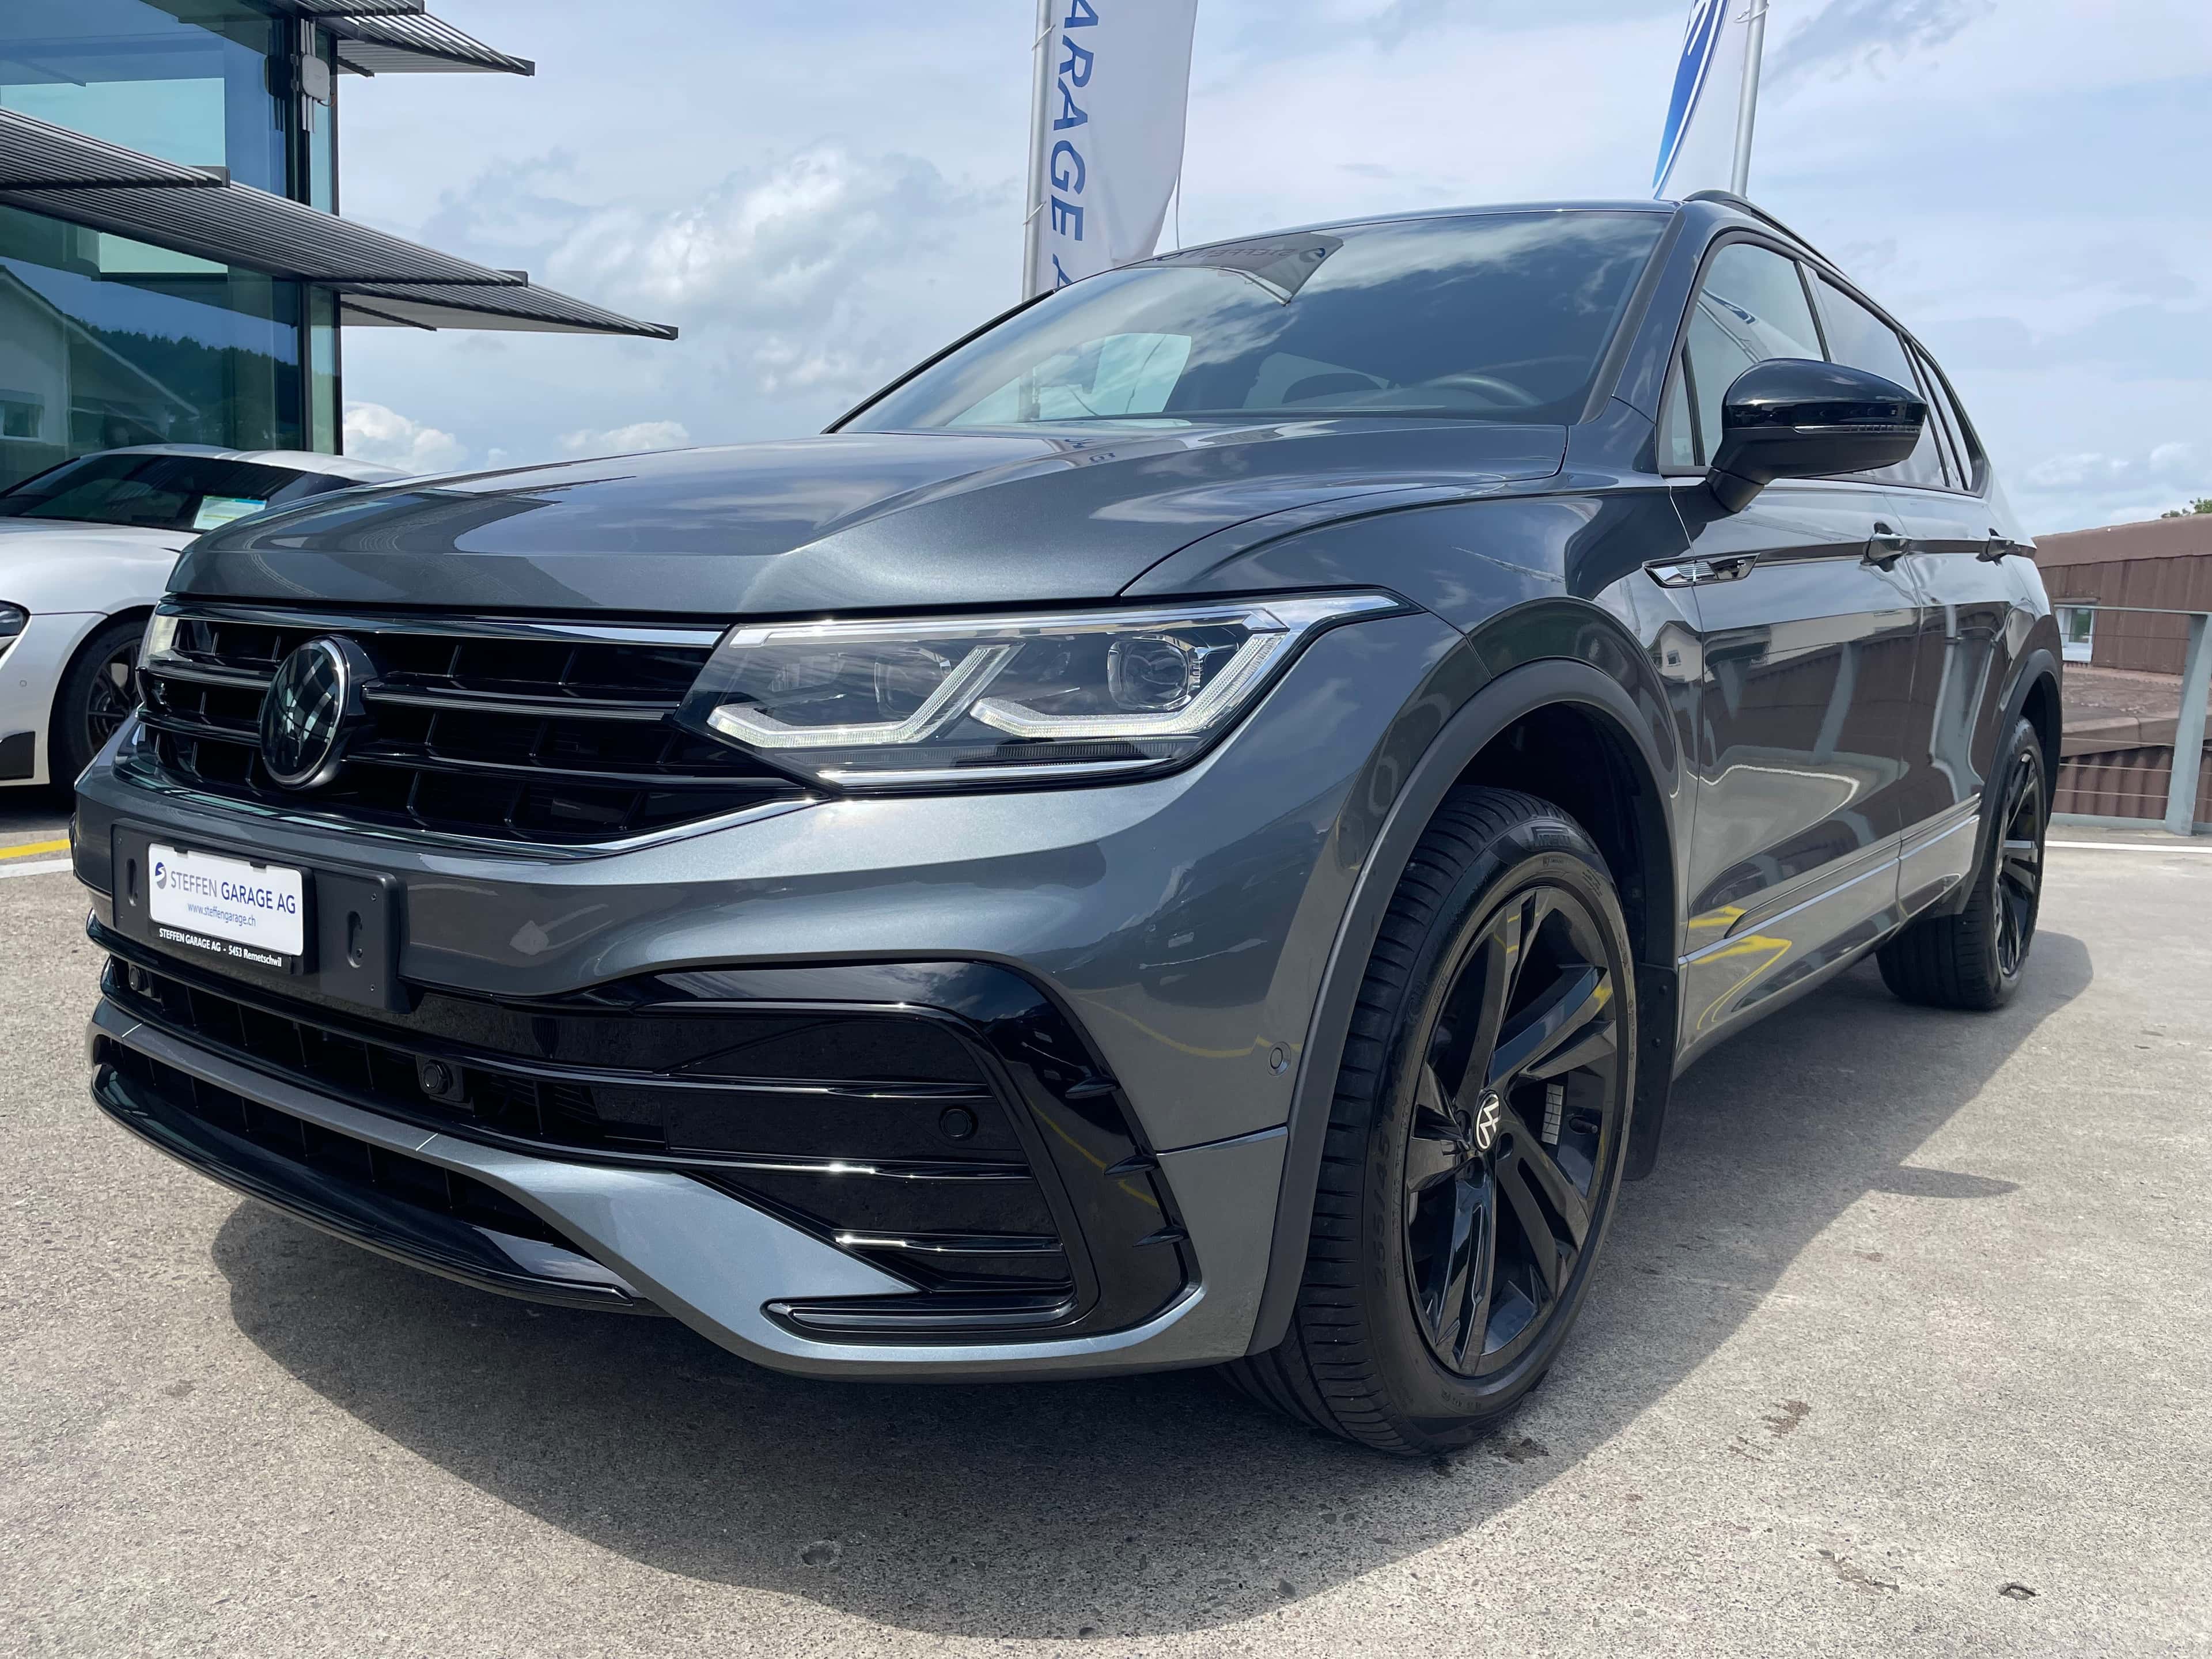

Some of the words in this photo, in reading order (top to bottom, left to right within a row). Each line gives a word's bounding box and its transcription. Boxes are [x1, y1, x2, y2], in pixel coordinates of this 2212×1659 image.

[171, 870, 217, 897] STEFFEN
[221, 881, 274, 910] GARAGE
[276, 893, 296, 914] AG
[187, 903, 256, 927] www.steffengarage.ch
[159, 927, 185, 943] STEFFEN
[185, 934, 210, 950] GARAGE
[211, 941, 221, 952] AG
[228, 945, 242, 957] 5453
[243, 948, 282, 967] Remetschwil
